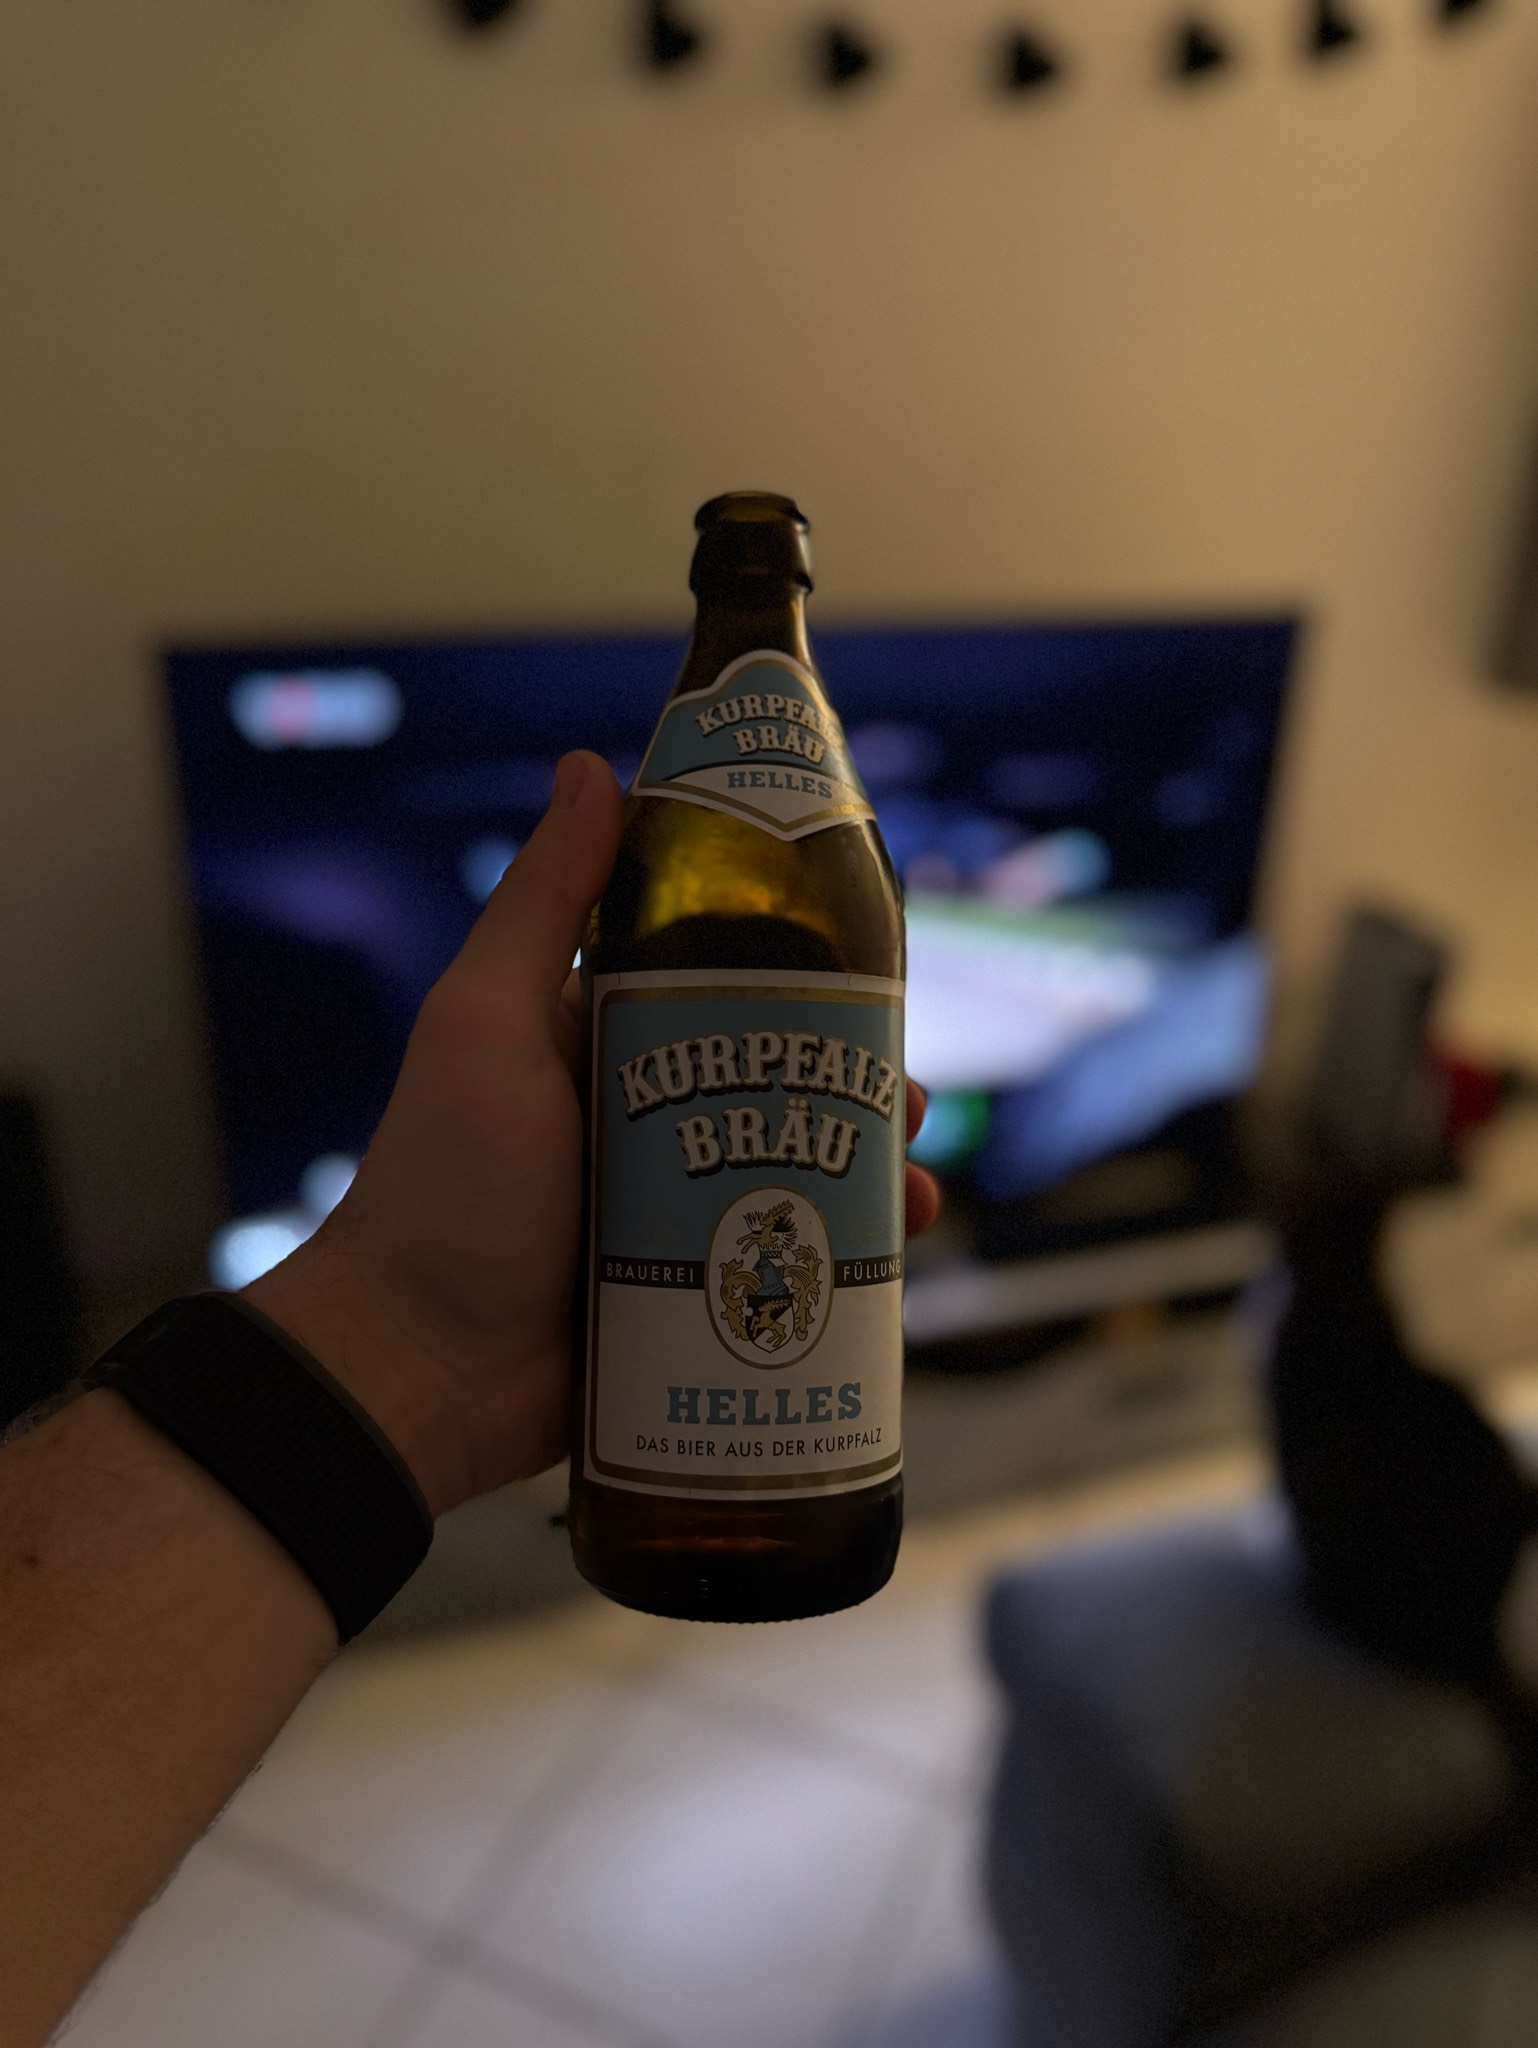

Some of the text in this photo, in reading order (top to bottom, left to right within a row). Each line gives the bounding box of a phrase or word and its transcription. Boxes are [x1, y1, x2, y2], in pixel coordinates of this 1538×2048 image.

[732, 723, 826, 765] BRÄU
[727, 771, 833, 799] HELLES
[616, 1030, 900, 1124] KURPFALZ
[674, 1096, 861, 1180] BRÄU
[605, 1258, 901, 1284] BRAUEREI FÜLLUNG
[667, 1382, 862, 1426] HELLES
[636, 1427, 882, 1457] DAS BIER AUS DER KURPFALZ
